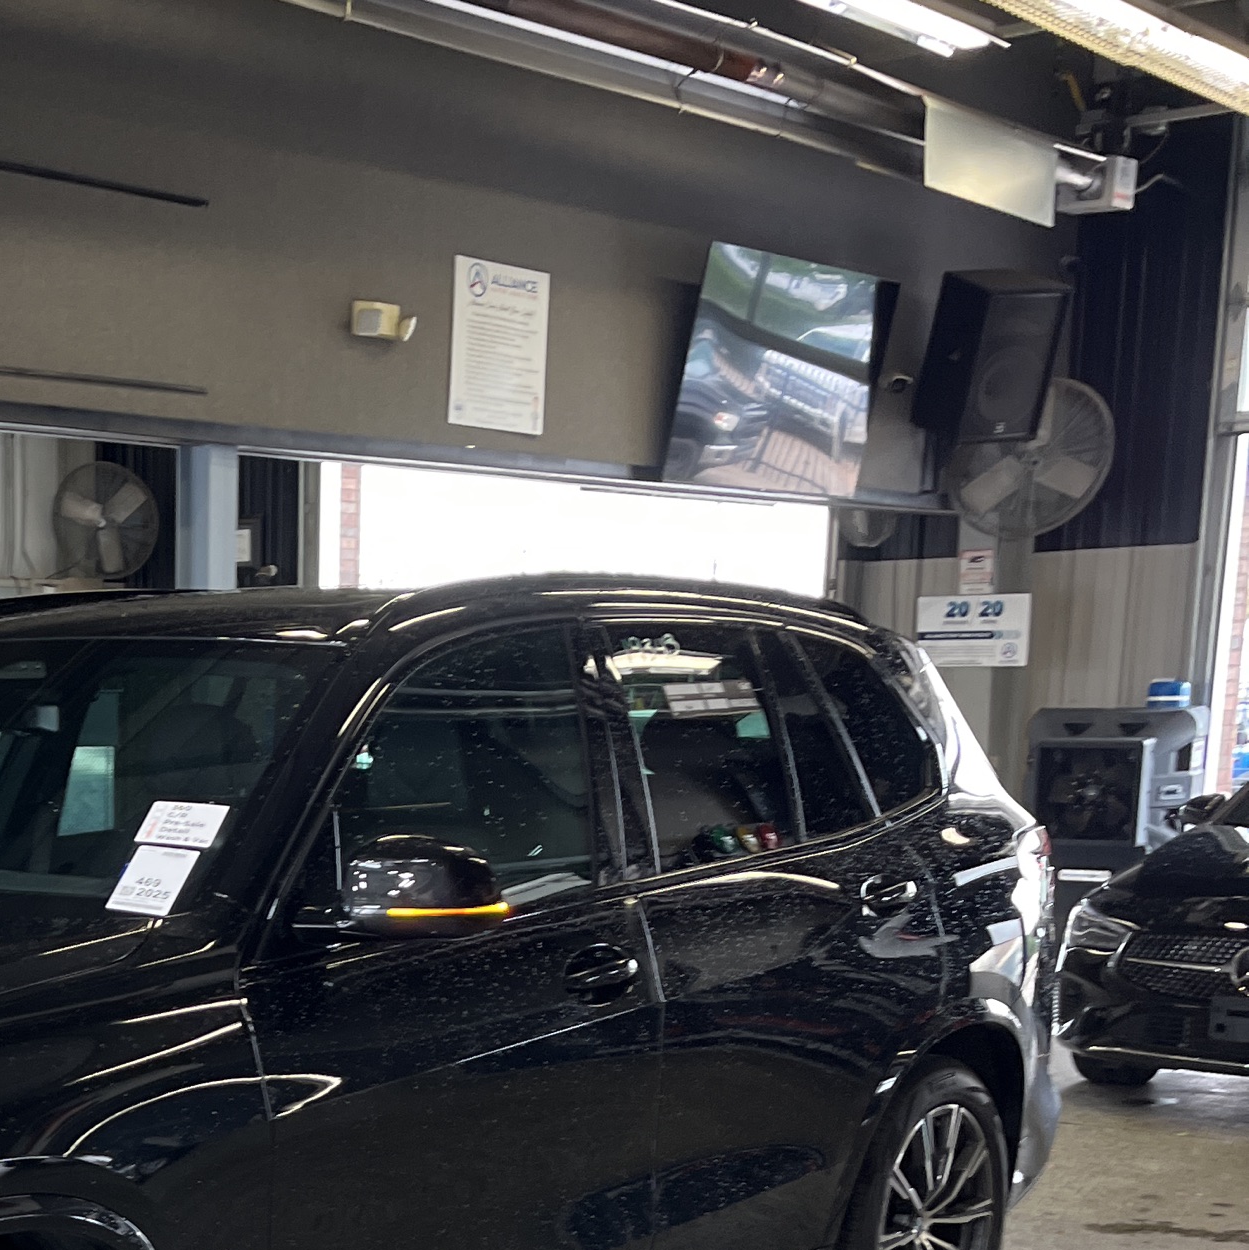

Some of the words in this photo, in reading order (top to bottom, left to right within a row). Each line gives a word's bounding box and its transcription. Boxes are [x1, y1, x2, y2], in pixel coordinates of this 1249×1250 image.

[944, 601, 970, 618] 20
[979, 600, 1004, 618] 20
[135, 887, 171, 900] 2025
